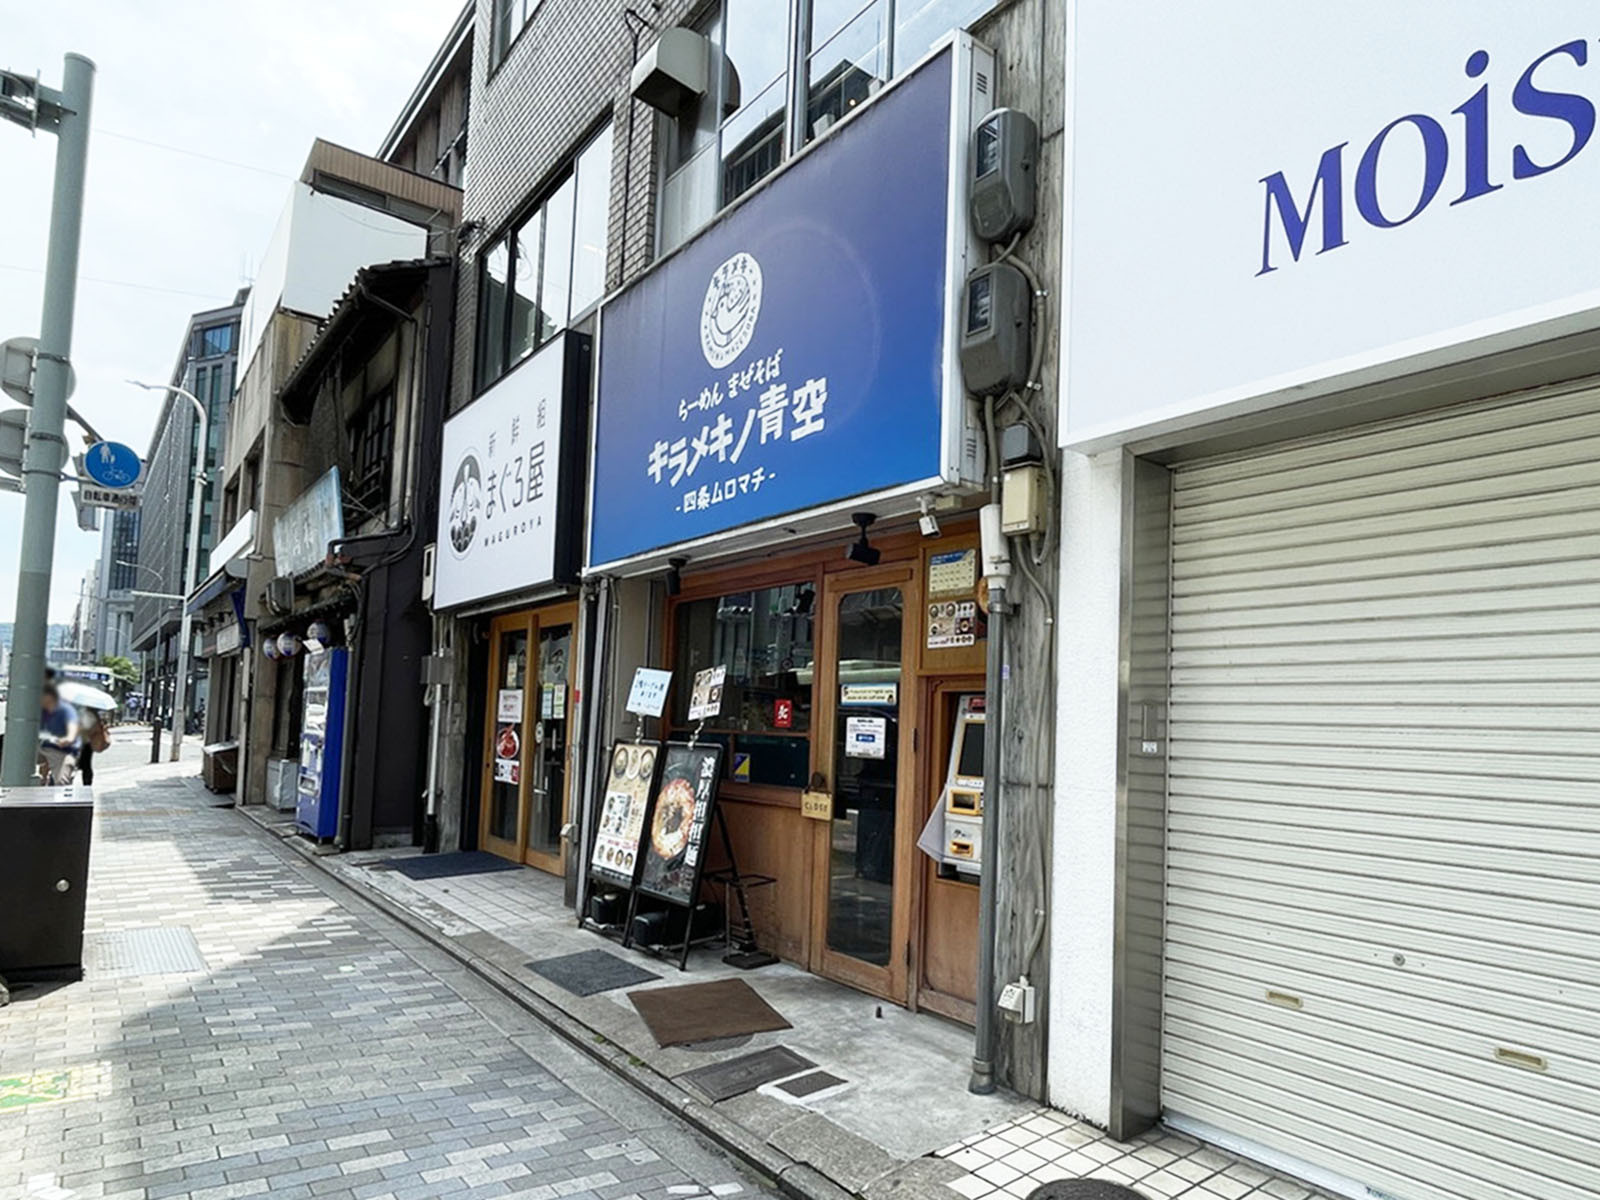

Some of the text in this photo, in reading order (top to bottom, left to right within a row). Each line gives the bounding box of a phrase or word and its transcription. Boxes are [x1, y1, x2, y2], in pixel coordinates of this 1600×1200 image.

[1254, 38, 1600, 277] MOiS
[678, 347, 783, 422] らーめん まぜそば
[647, 376, 829, 487] キラメキノ青空
[484, 440, 546, 520] まぐろ屋
[483, 515, 543, 548] MAGUROYA
